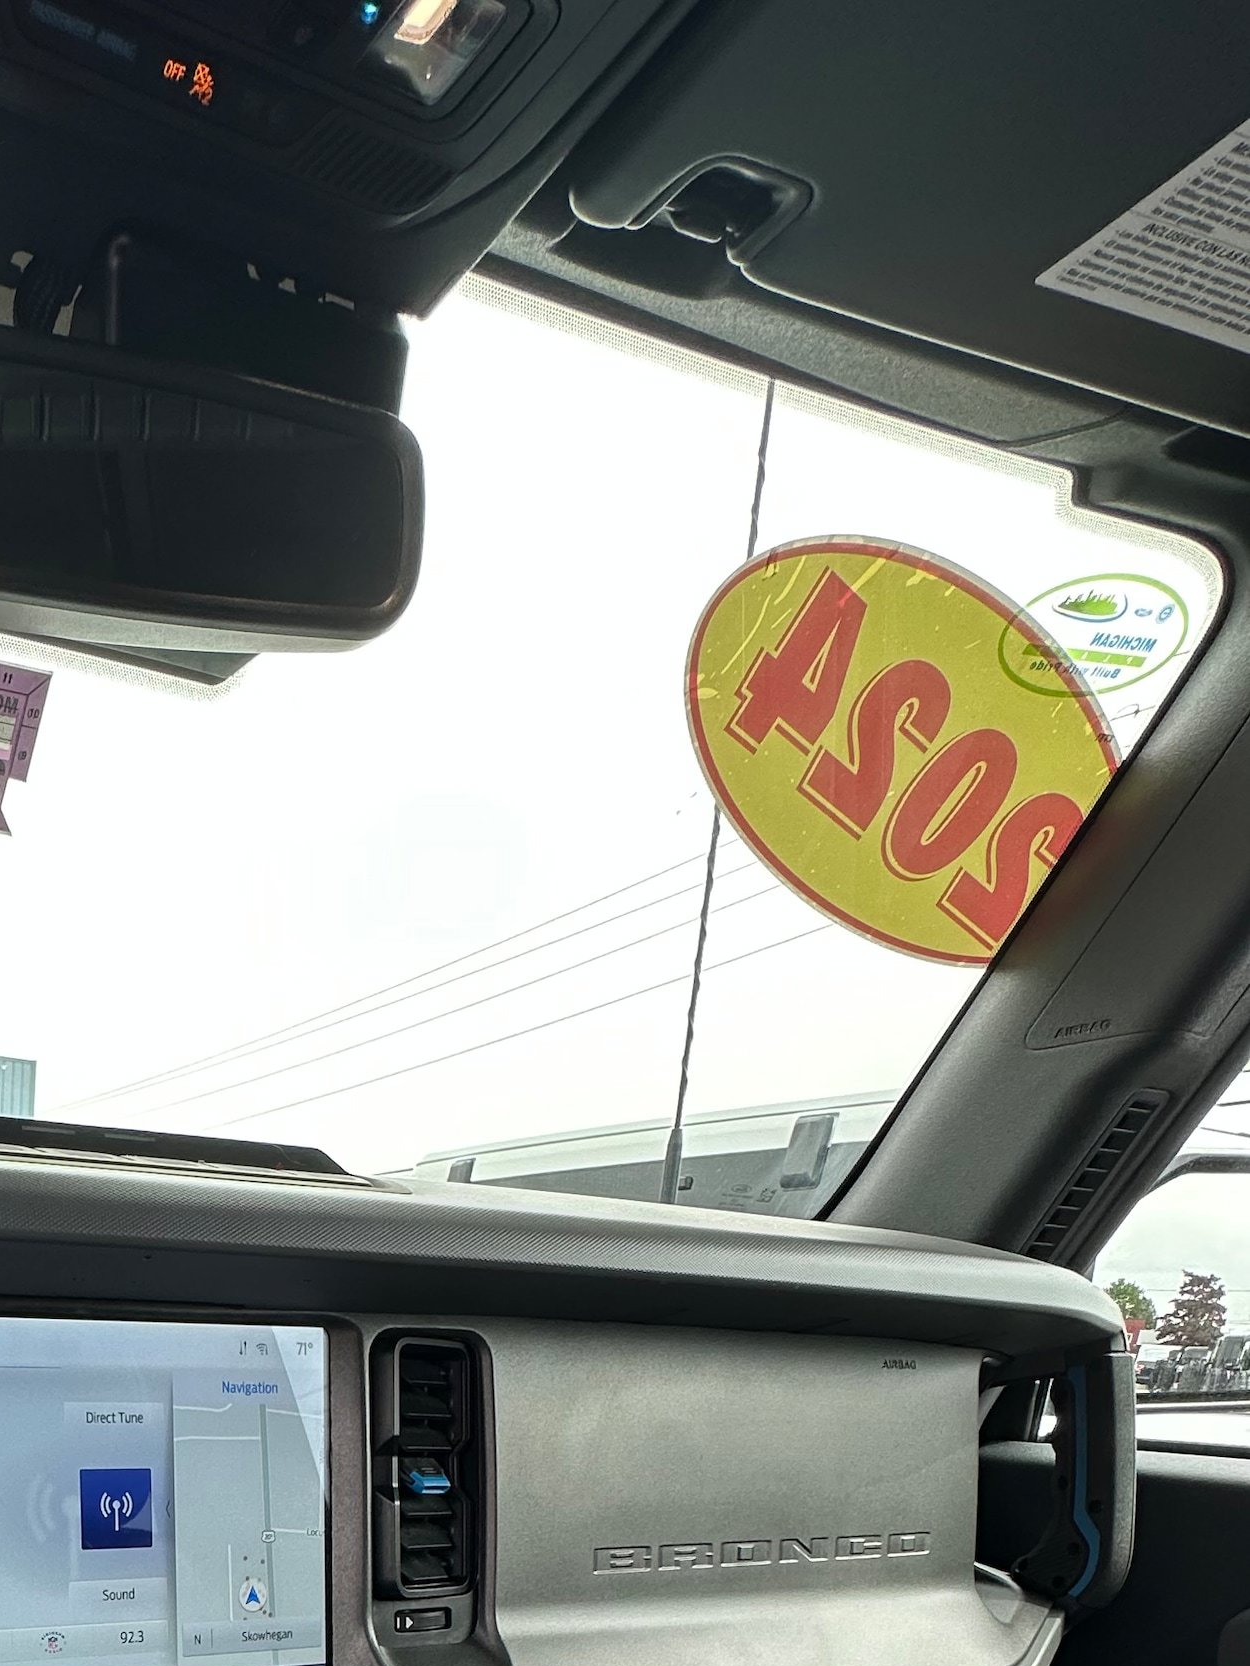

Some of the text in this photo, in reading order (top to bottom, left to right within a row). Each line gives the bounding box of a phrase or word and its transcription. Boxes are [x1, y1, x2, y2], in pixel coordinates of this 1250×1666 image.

[163, 59, 187, 82] OFF
[1054, 1018, 1112, 1040] AIRBAG
[881, 1359, 917, 1370] AIRBAG
[221, 1380, 279, 1396] Navigation
[85, 1411, 144, 1424] Direct Tune
[592, 1531, 932, 1576] BRONCO
[102, 1588, 135, 1602] Sound
[120, 1630, 144, 1645] 92.3
[193, 1634, 202, 1646] N
[241, 1628, 293, 1642] Skowhegan
